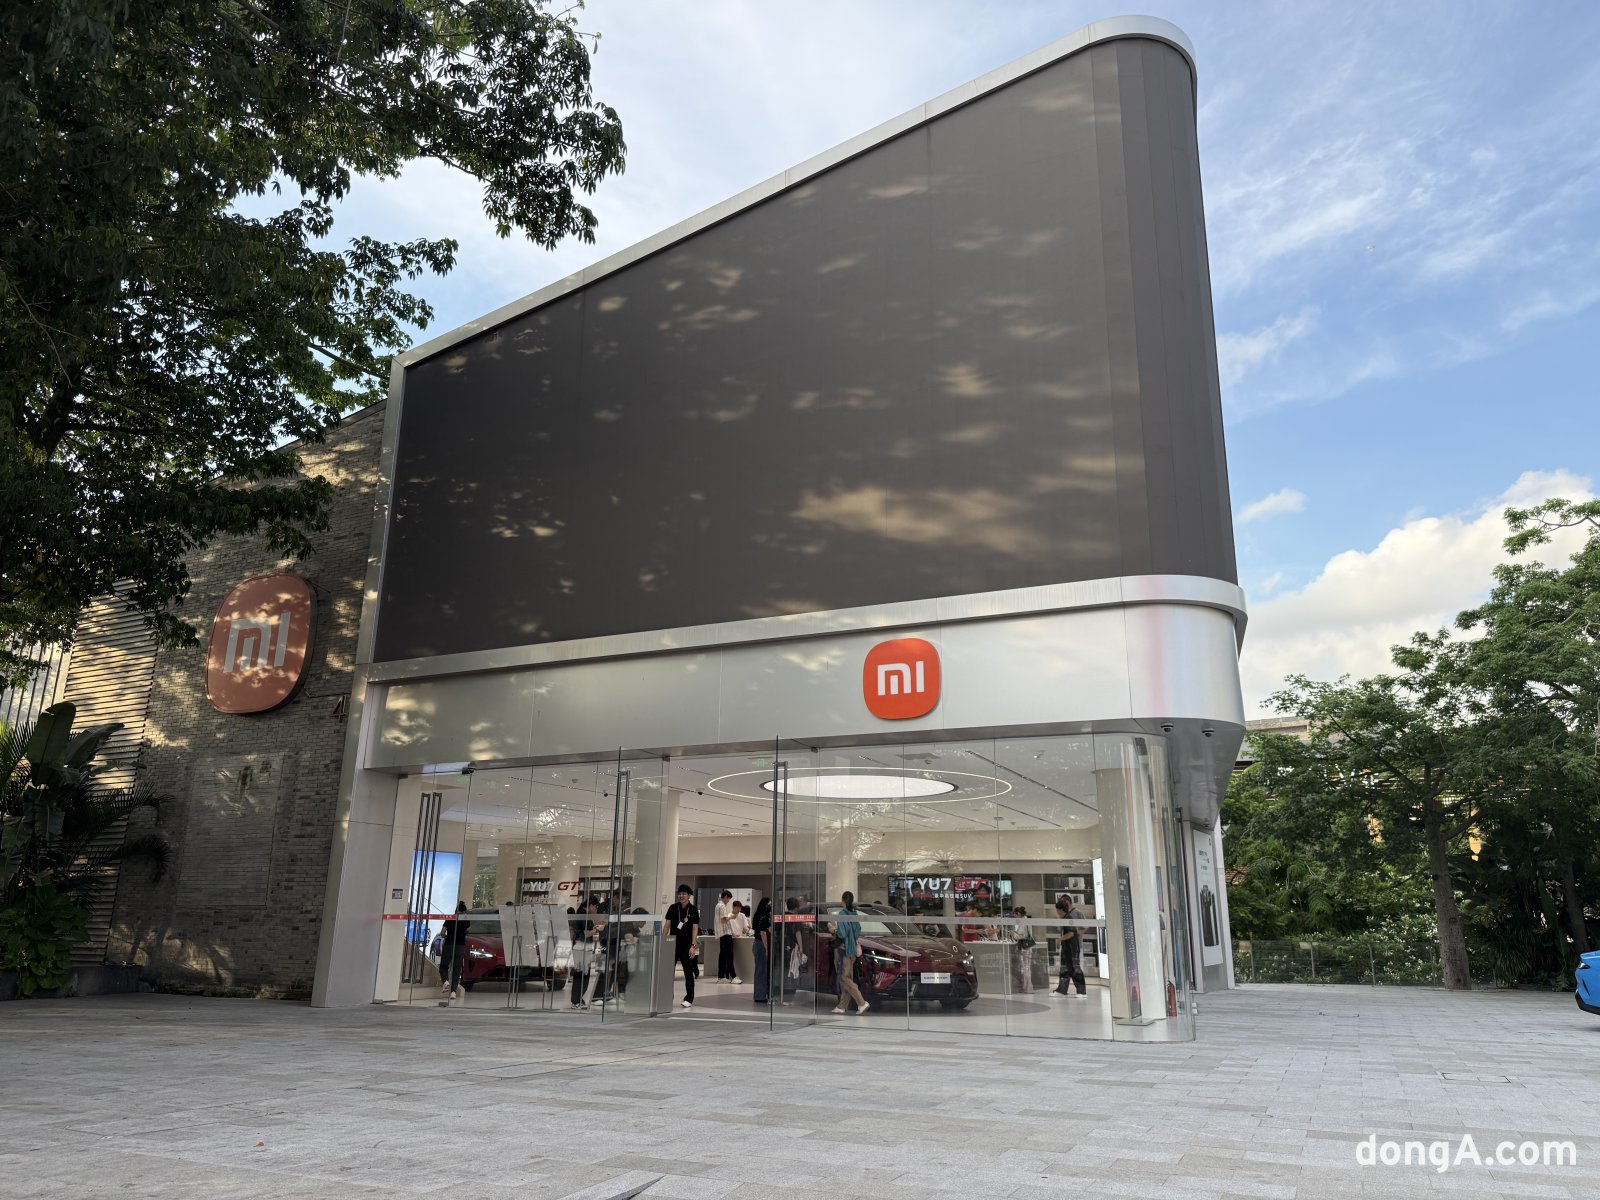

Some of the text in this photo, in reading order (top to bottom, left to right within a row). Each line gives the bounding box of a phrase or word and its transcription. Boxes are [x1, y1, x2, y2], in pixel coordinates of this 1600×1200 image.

[529, 881, 581, 891] YU7 GT
[917, 877, 952, 890] YU7
